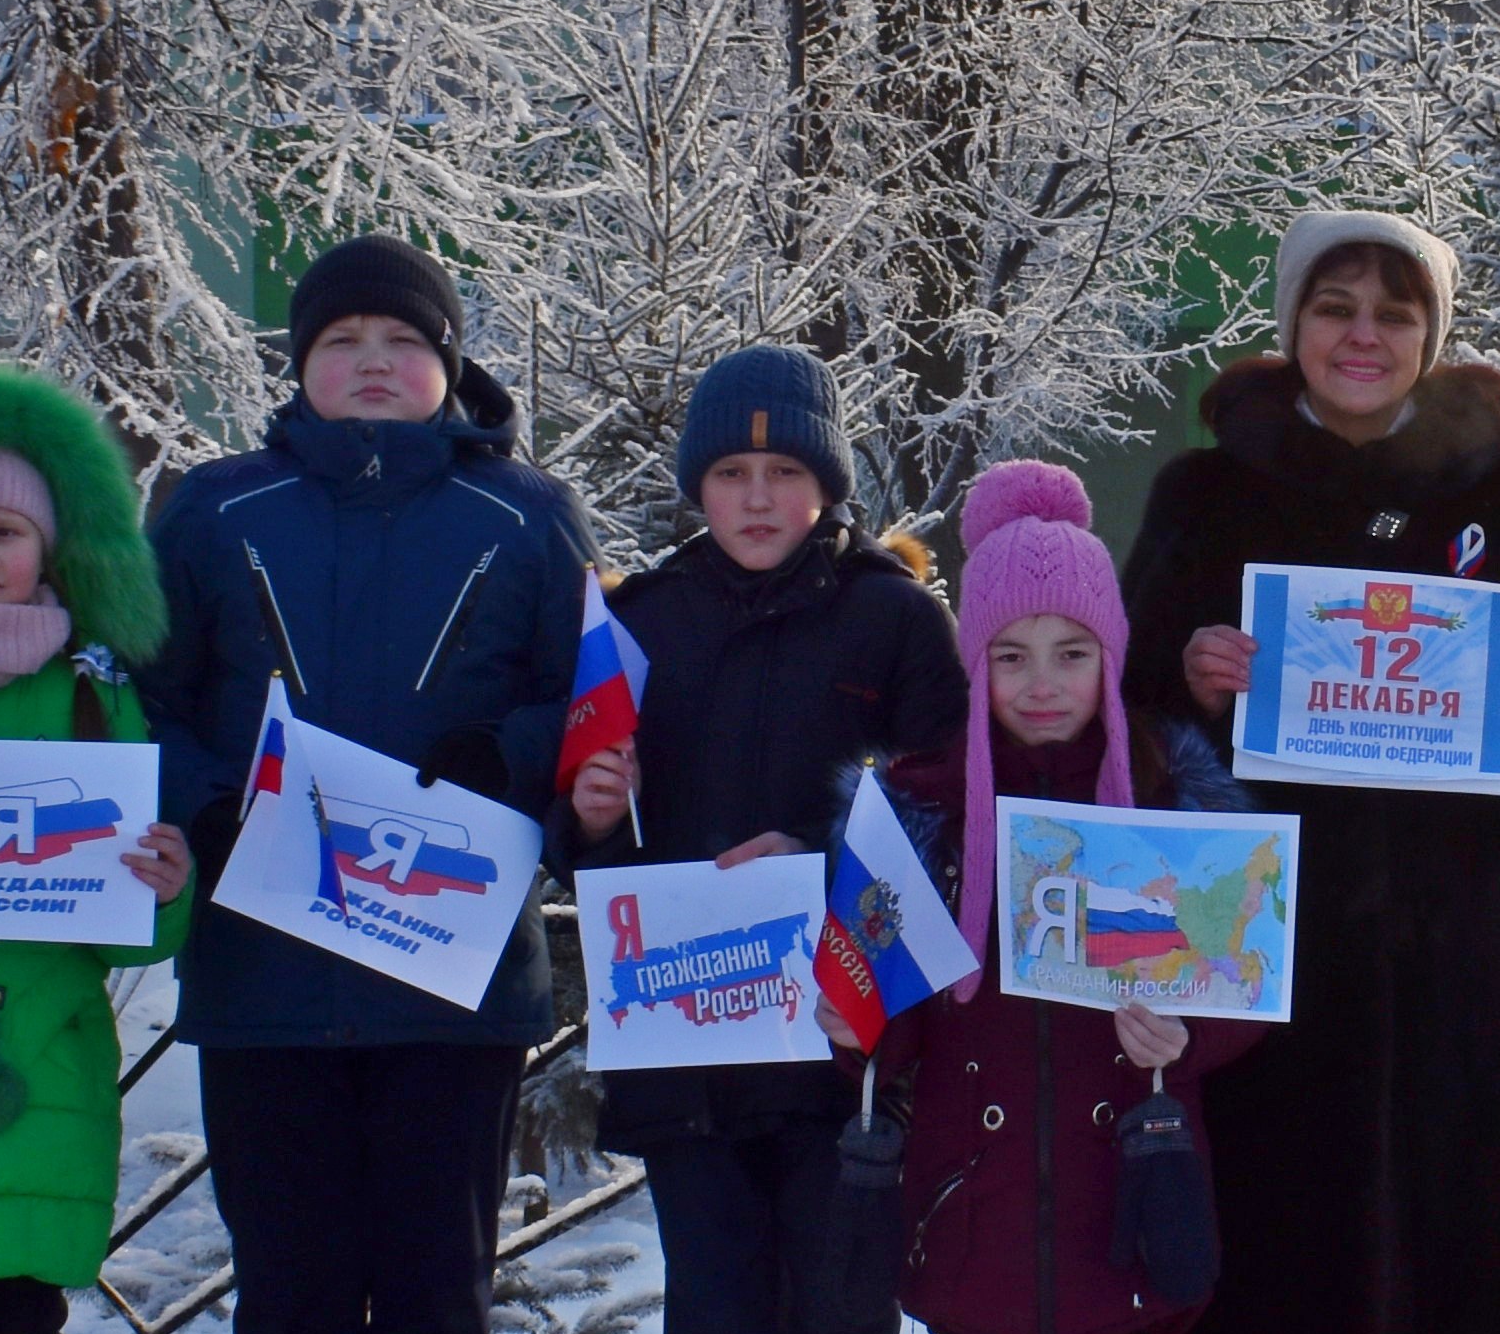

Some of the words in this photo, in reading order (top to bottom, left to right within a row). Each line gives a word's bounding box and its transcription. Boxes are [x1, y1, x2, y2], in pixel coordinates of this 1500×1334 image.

[1353, 635, 1422, 683] 12
[1307, 680, 1461, 717] ДЕКАБРЯ
[1285, 737, 1381, 761] РОССИЙСКОЙ
[1385, 746, 1474, 767] ФЕДЕРАЦИИ
[1307, 717, 1345, 735] ДЕНЬ
[1349, 720, 1454, 745] КОНСТИТУЦИИ
[355, 818, 428, 885] Я
[308, 899, 421, 955] РОССИИ!
[608, 893, 645, 963] Я
[1031, 876, 1079, 964] Я
[635, 938, 772, 997] гражданин
[694, 956, 795, 1020] России!
[1027, 965, 1130, 997] ГРАЖДАНИН
[1134, 979, 1206, 998] РОССИИ
